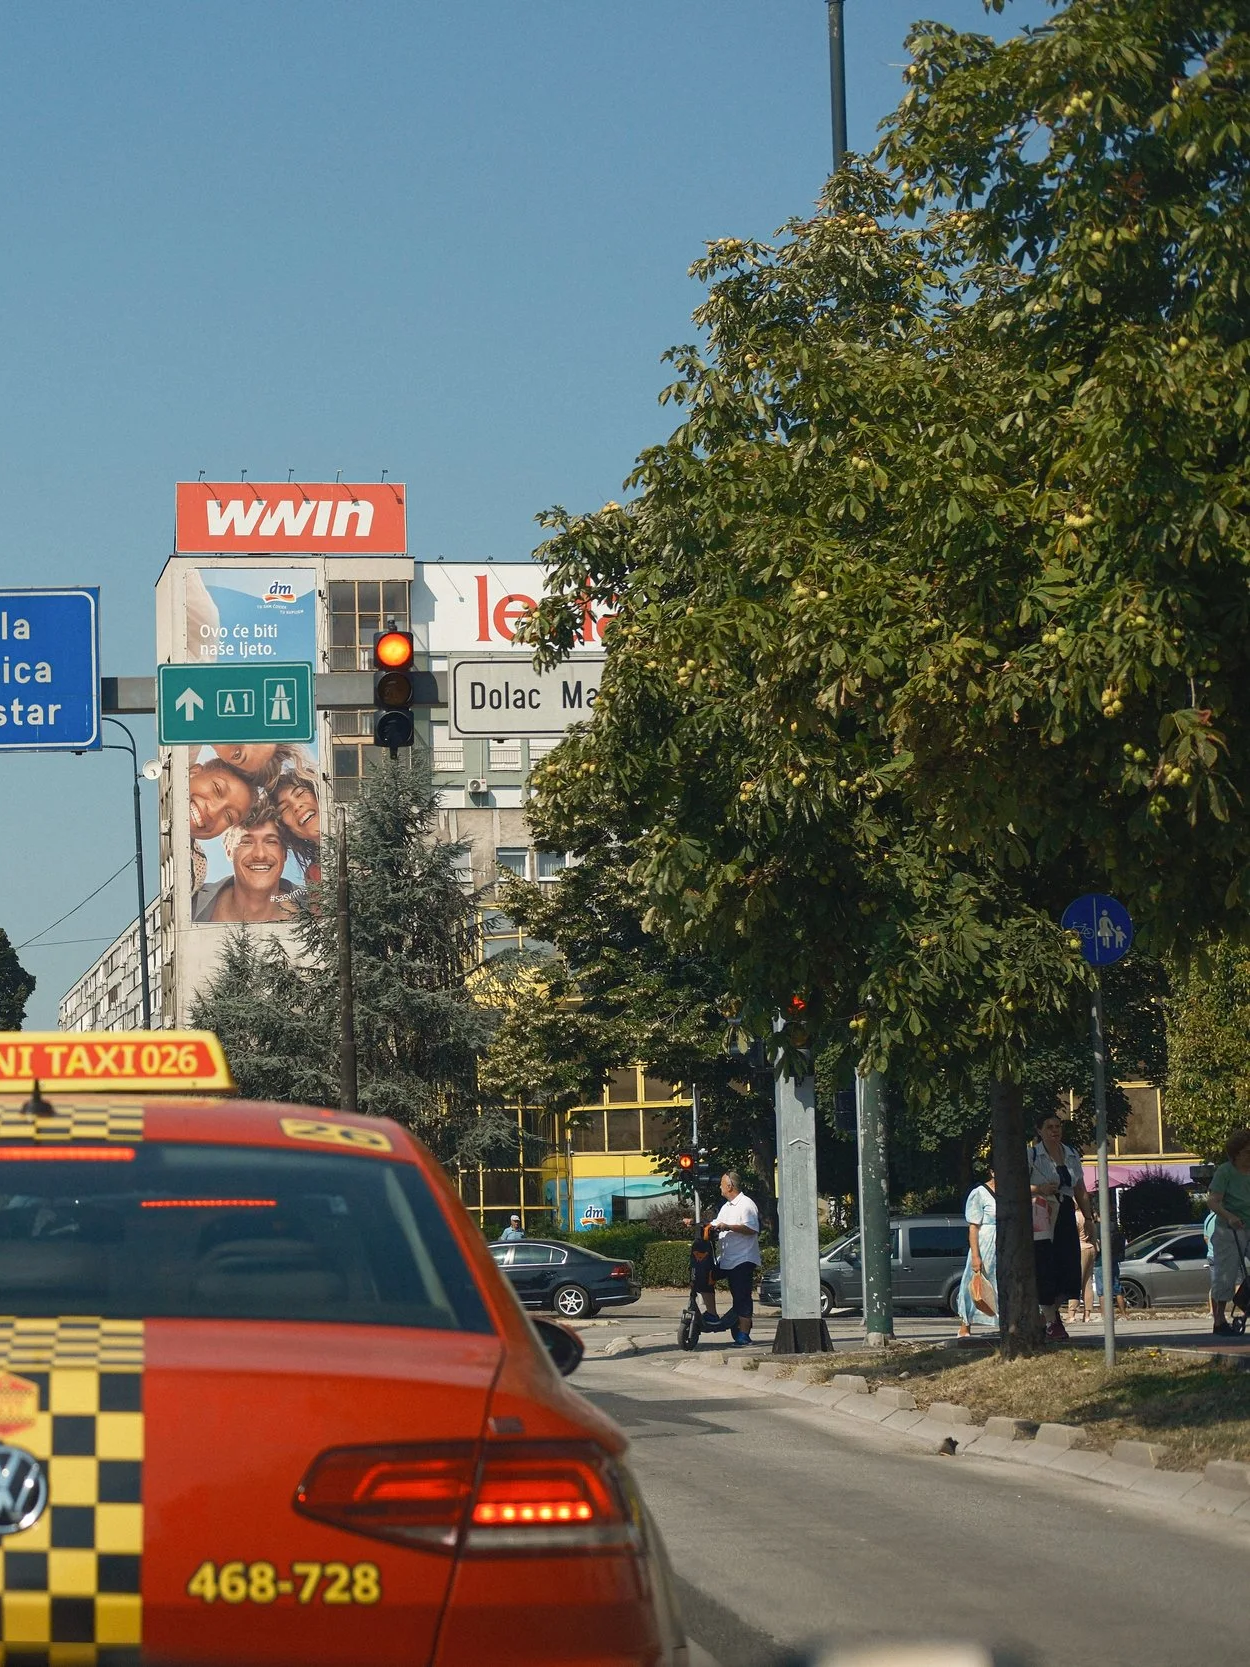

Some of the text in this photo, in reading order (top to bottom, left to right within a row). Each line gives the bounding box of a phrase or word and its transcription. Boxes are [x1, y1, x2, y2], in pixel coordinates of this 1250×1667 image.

[269, 582, 292, 595] dm
[199, 623, 278, 638] Ovo će biti
[200, 641, 277, 659] naše ljeto.
[470, 681, 541, 710] Dolac
[45, 1044, 137, 1077] TAXI
[140, 1043, 199, 1076] 026
[585, 1205, 603, 1218] dm
[187, 1561, 381, 1604] 468-728
